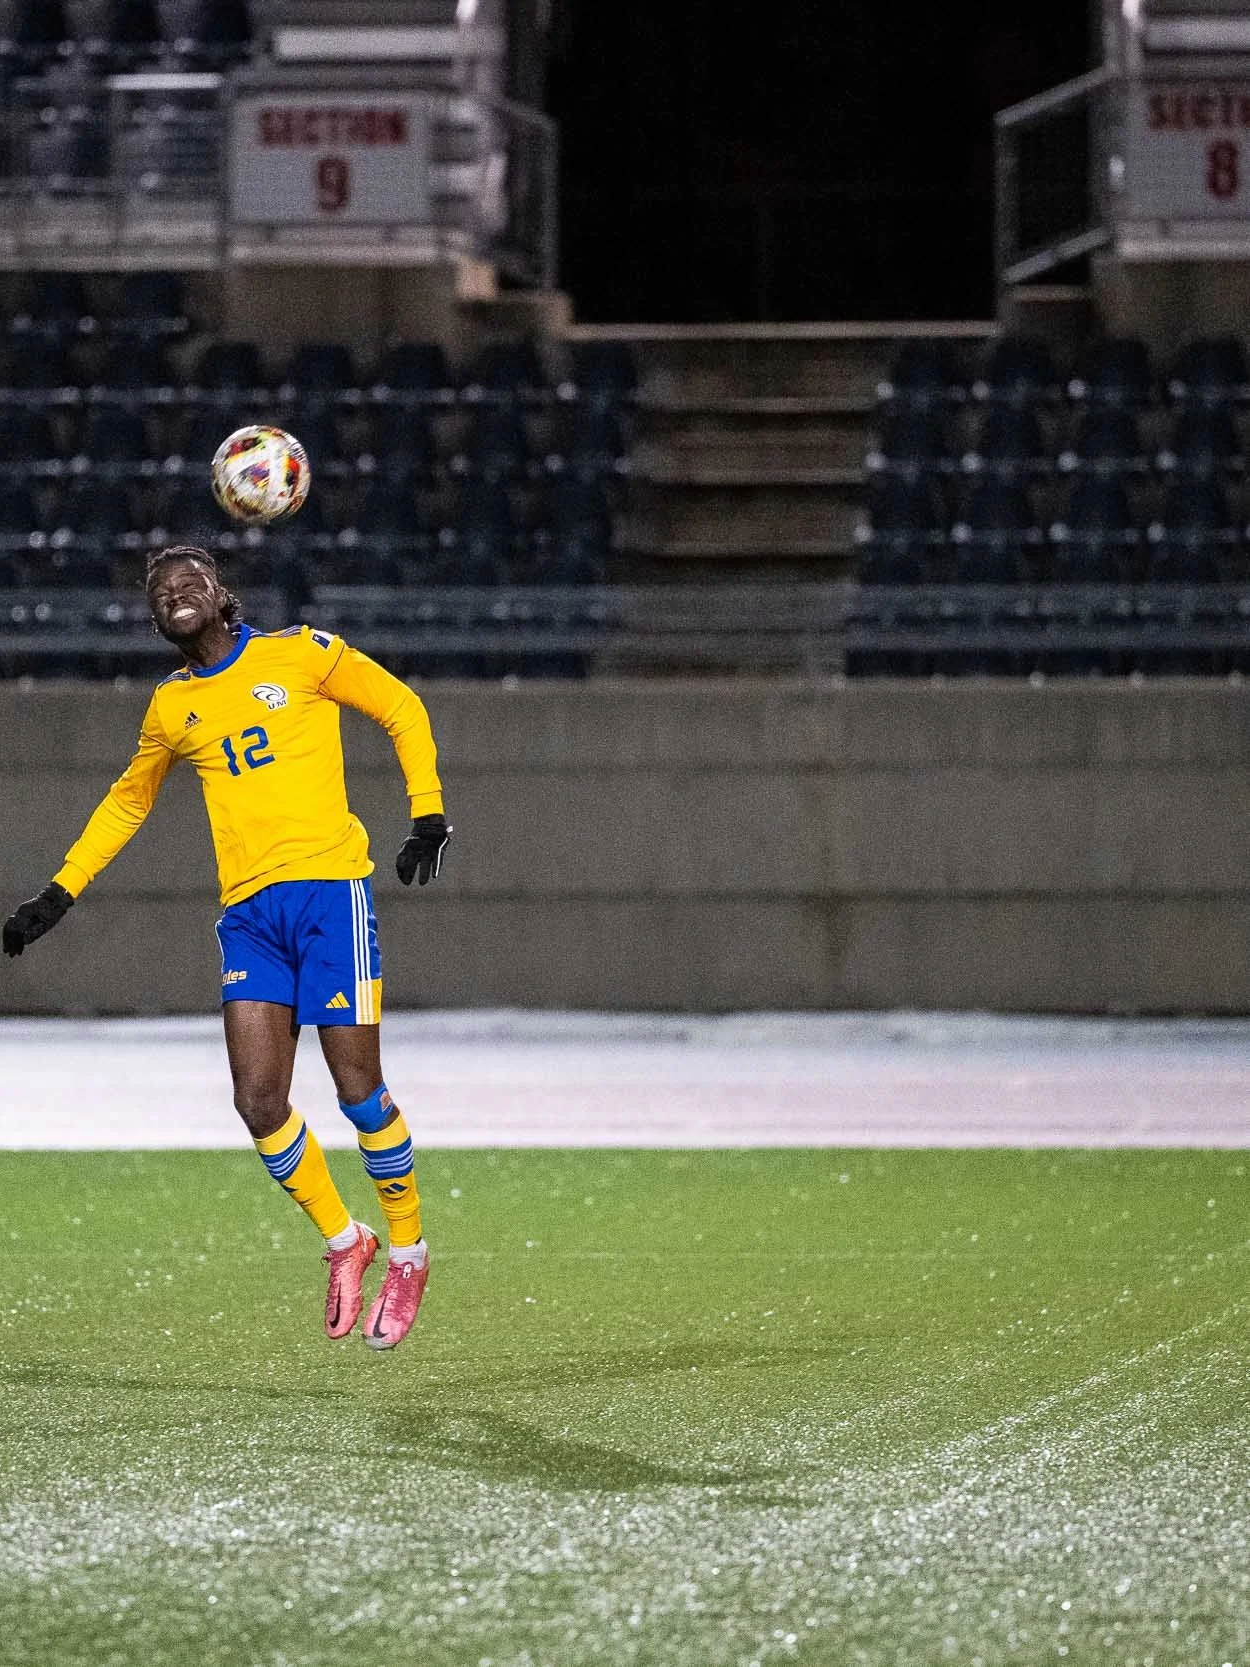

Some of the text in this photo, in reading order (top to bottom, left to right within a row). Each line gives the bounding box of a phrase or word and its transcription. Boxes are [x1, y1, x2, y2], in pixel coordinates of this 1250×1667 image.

[260, 107, 407, 145] SECTION
[318, 157, 351, 212] 9
[1206, 140, 1239, 200] 8
[221, 726, 275, 776] 12
